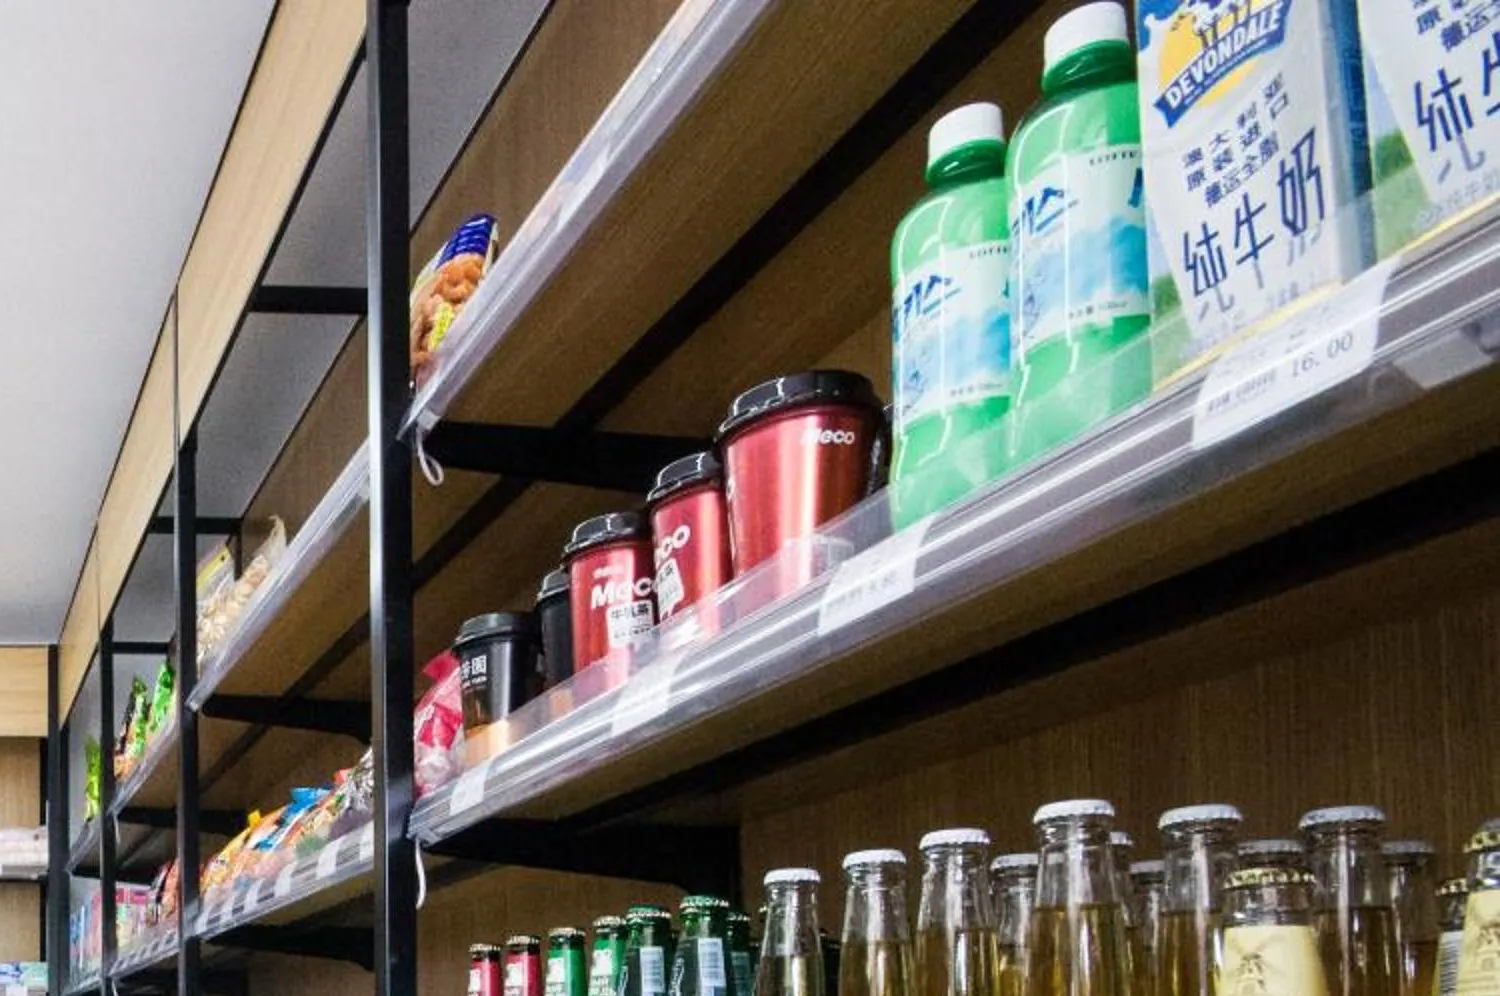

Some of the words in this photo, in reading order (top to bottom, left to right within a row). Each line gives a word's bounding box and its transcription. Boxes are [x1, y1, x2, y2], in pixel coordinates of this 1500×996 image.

[1165, 1, 1284, 109] DEVONDALE
[1183, 126, 1325, 312] 纯牛奶
